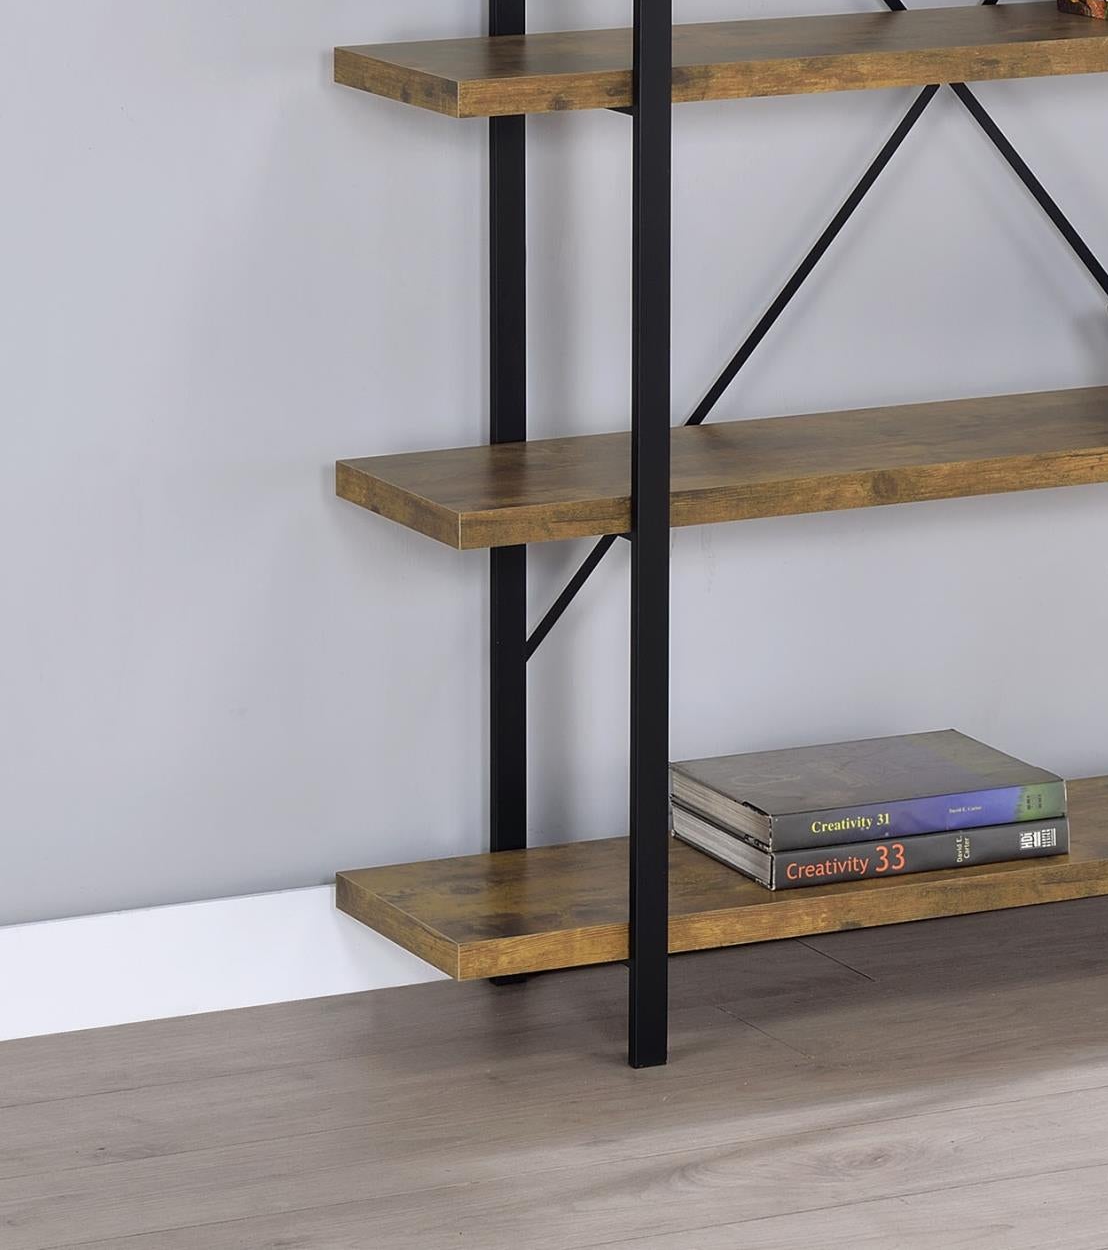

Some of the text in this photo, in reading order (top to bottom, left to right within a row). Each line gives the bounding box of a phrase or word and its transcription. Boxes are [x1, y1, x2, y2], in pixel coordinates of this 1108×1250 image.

[812, 813, 891, 833] Creativity 31
[786, 842, 906, 880] Creativity 33
